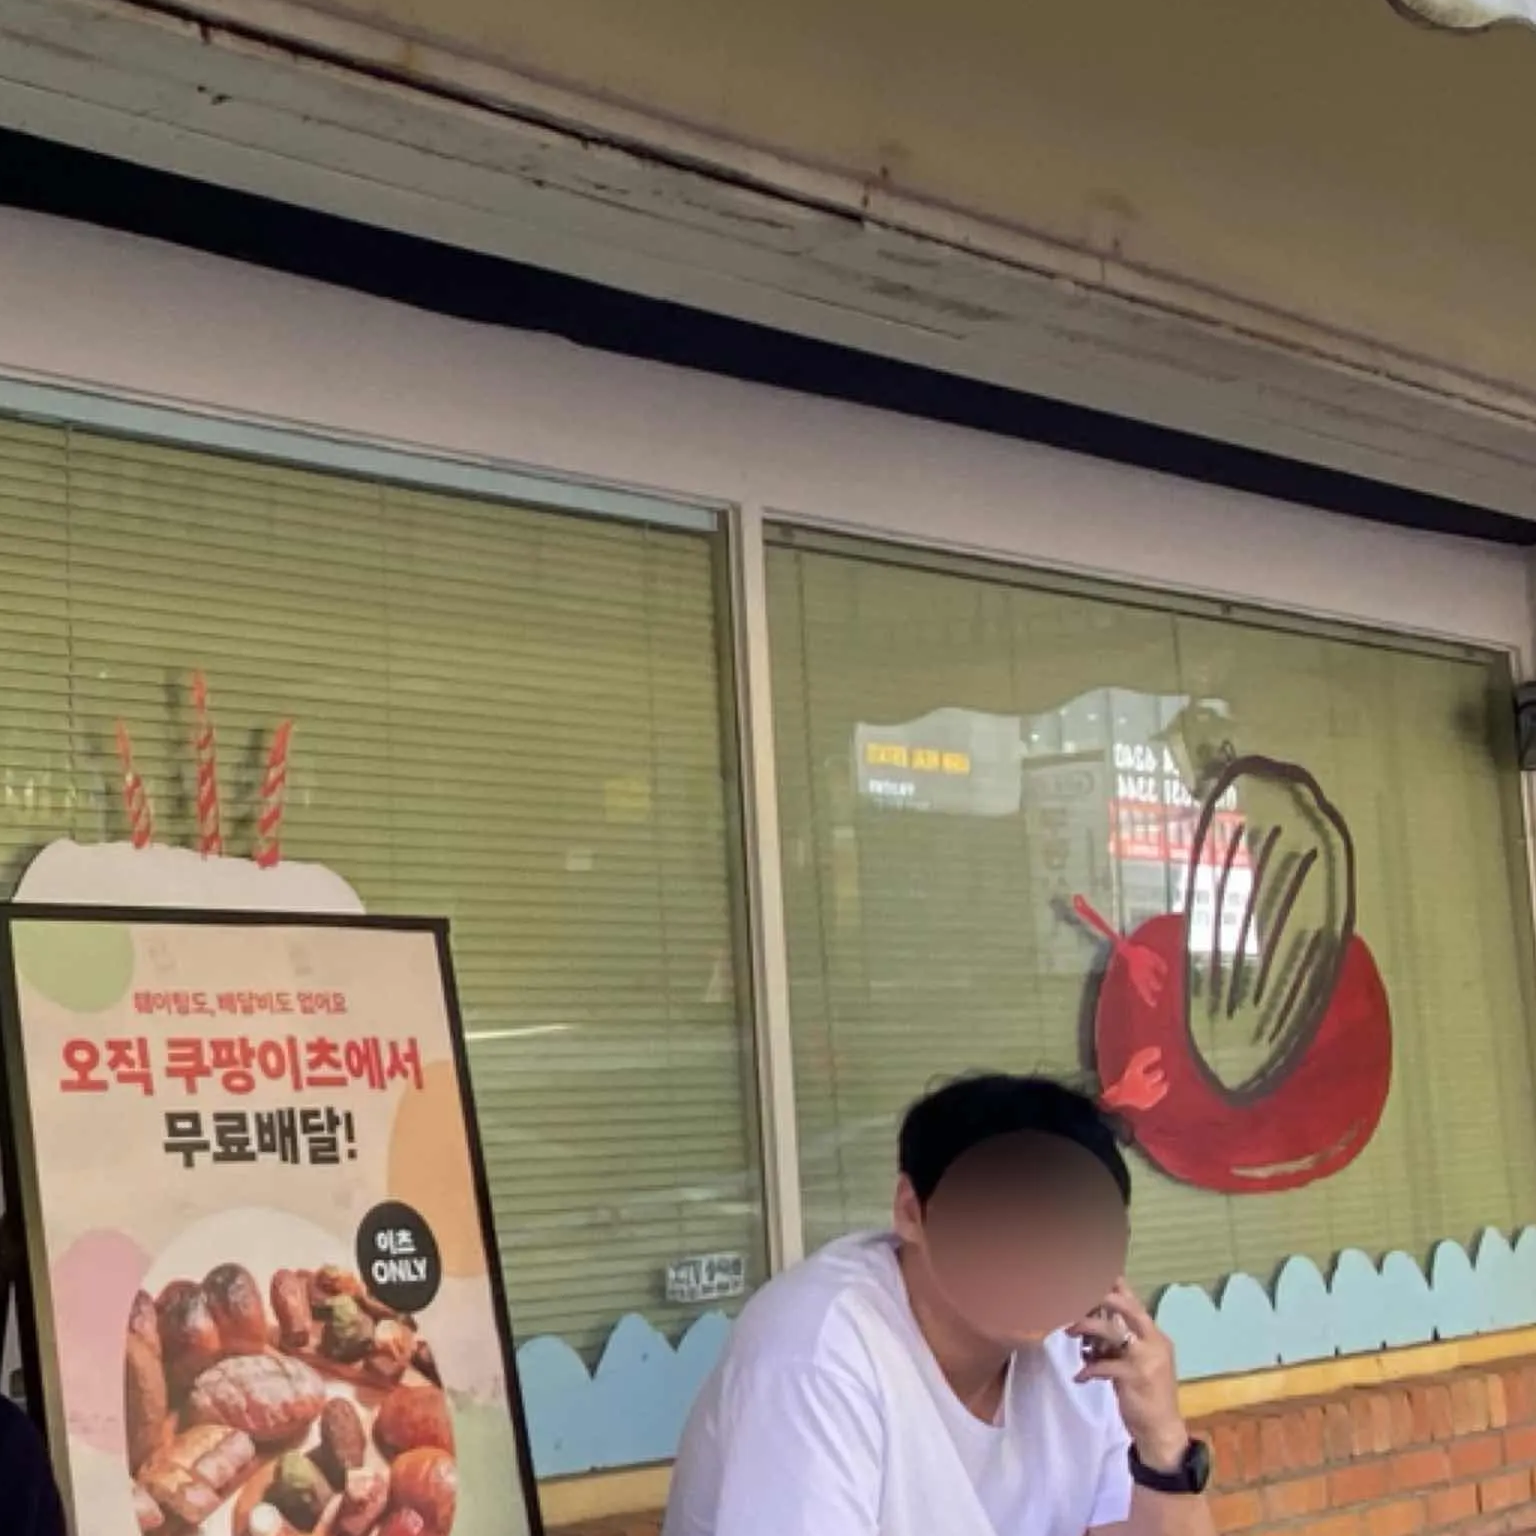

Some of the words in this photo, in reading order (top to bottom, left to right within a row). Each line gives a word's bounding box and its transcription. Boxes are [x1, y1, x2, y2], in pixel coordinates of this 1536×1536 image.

[216, 990, 295, 1016] 배달비도
[296, 991, 349, 1015] 없어요
[59, 1035, 156, 1096] 오직
[164, 1034, 425, 1096] 쿠팡이츠에서
[163, 1106, 358, 1169] 무료배달!
[375, 1229, 417, 1255] 이츠
[371, 1256, 428, 1285] ONLY
